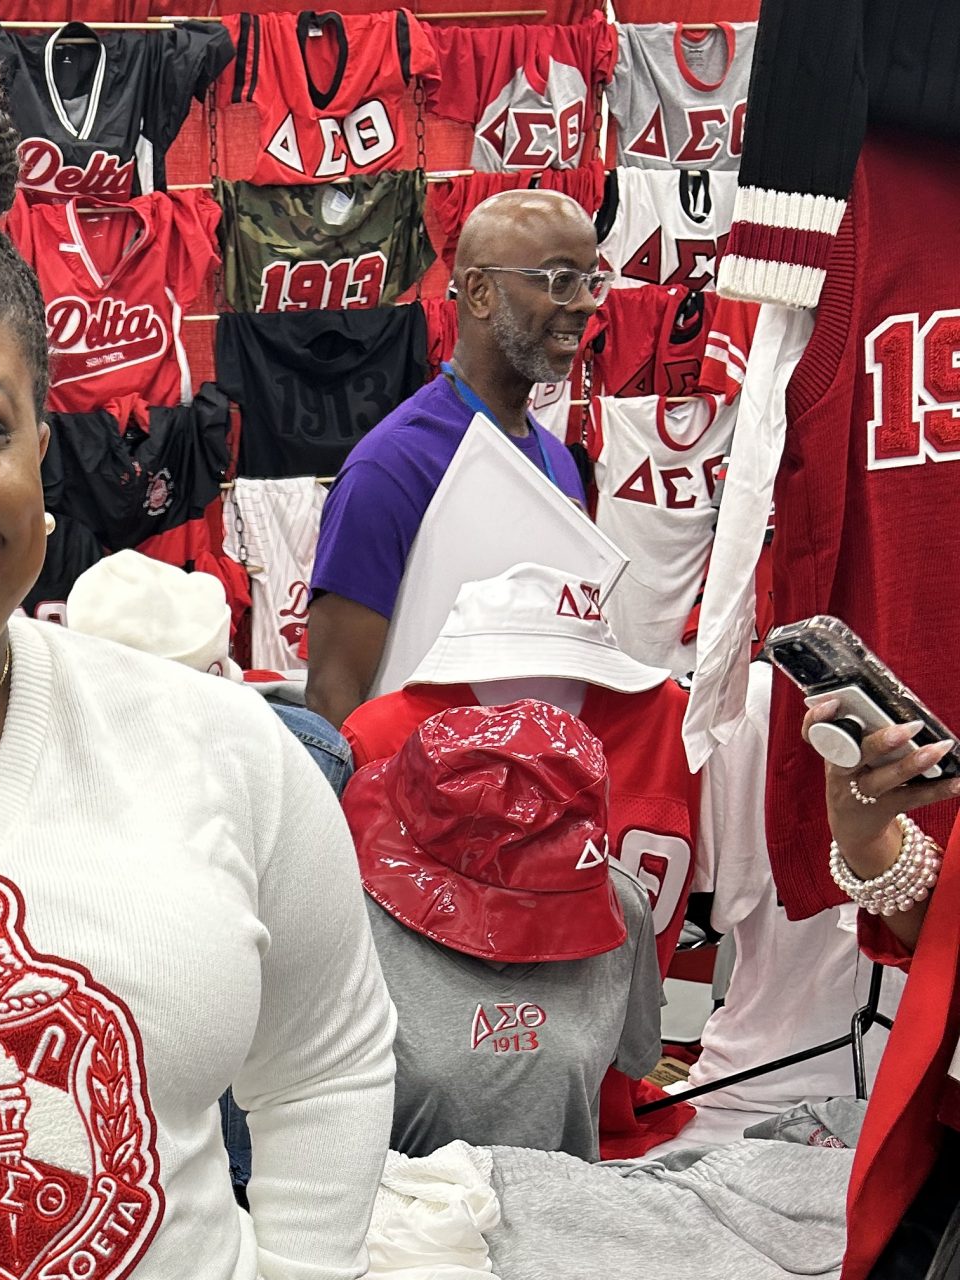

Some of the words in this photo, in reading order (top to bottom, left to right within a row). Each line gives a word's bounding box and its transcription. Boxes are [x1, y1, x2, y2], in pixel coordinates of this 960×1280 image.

[17, 137, 135, 194] Delta
[267, 100, 395, 177] ΔΣΘ
[256, 251, 387, 313] 1913
[621, 226, 732, 291] ΔΣ
[471, 1003, 547, 1050] ΔΣΘ
[493, 1031, 539, 1053] 1913
